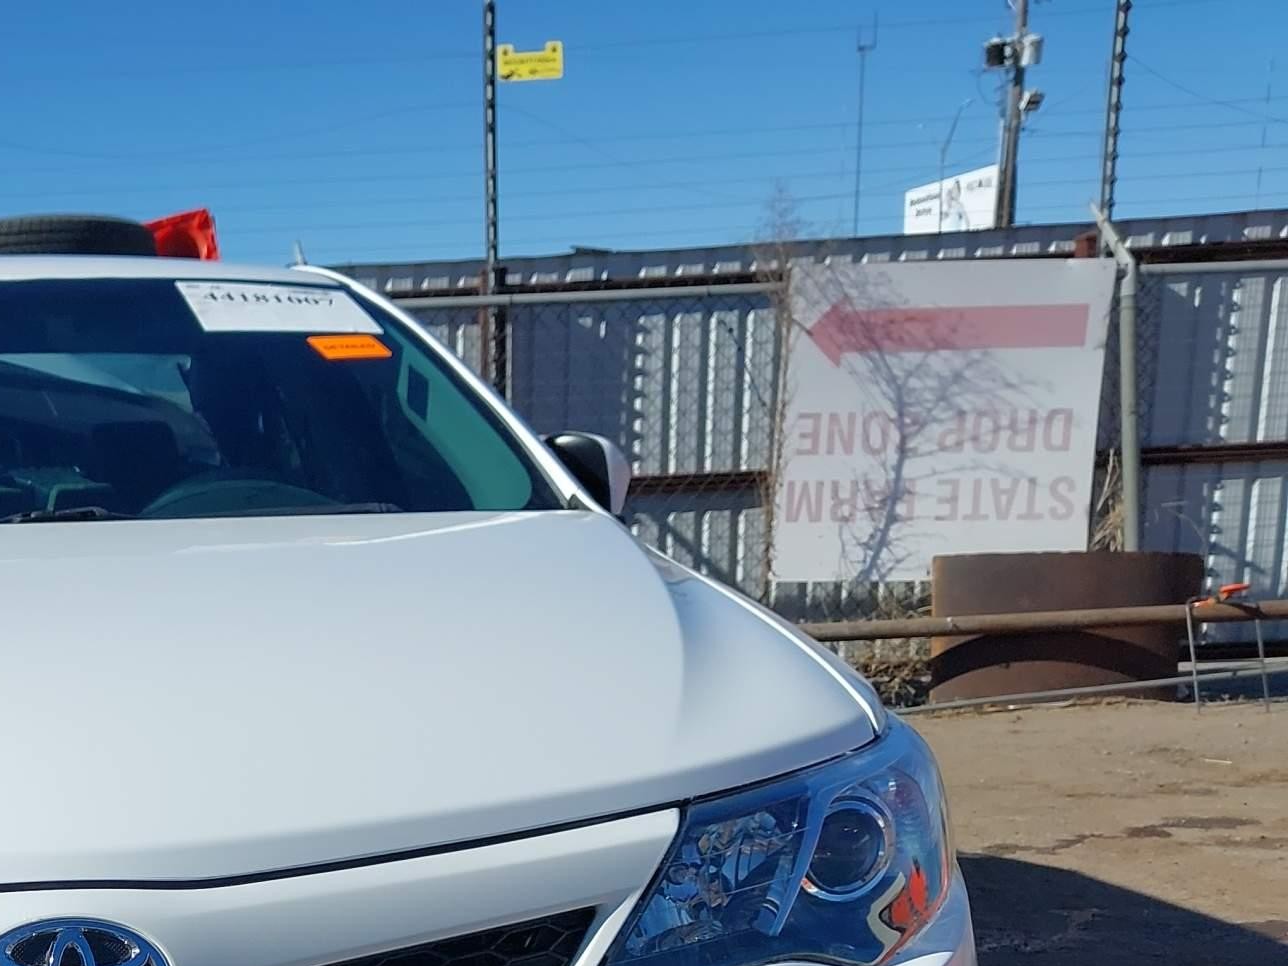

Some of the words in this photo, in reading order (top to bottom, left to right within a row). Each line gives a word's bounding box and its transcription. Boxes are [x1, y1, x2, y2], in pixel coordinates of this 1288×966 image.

[938, 408, 1074, 452] DROP
[785, 479, 917, 523] FARM
[934, 476, 1076, 521] STATE
